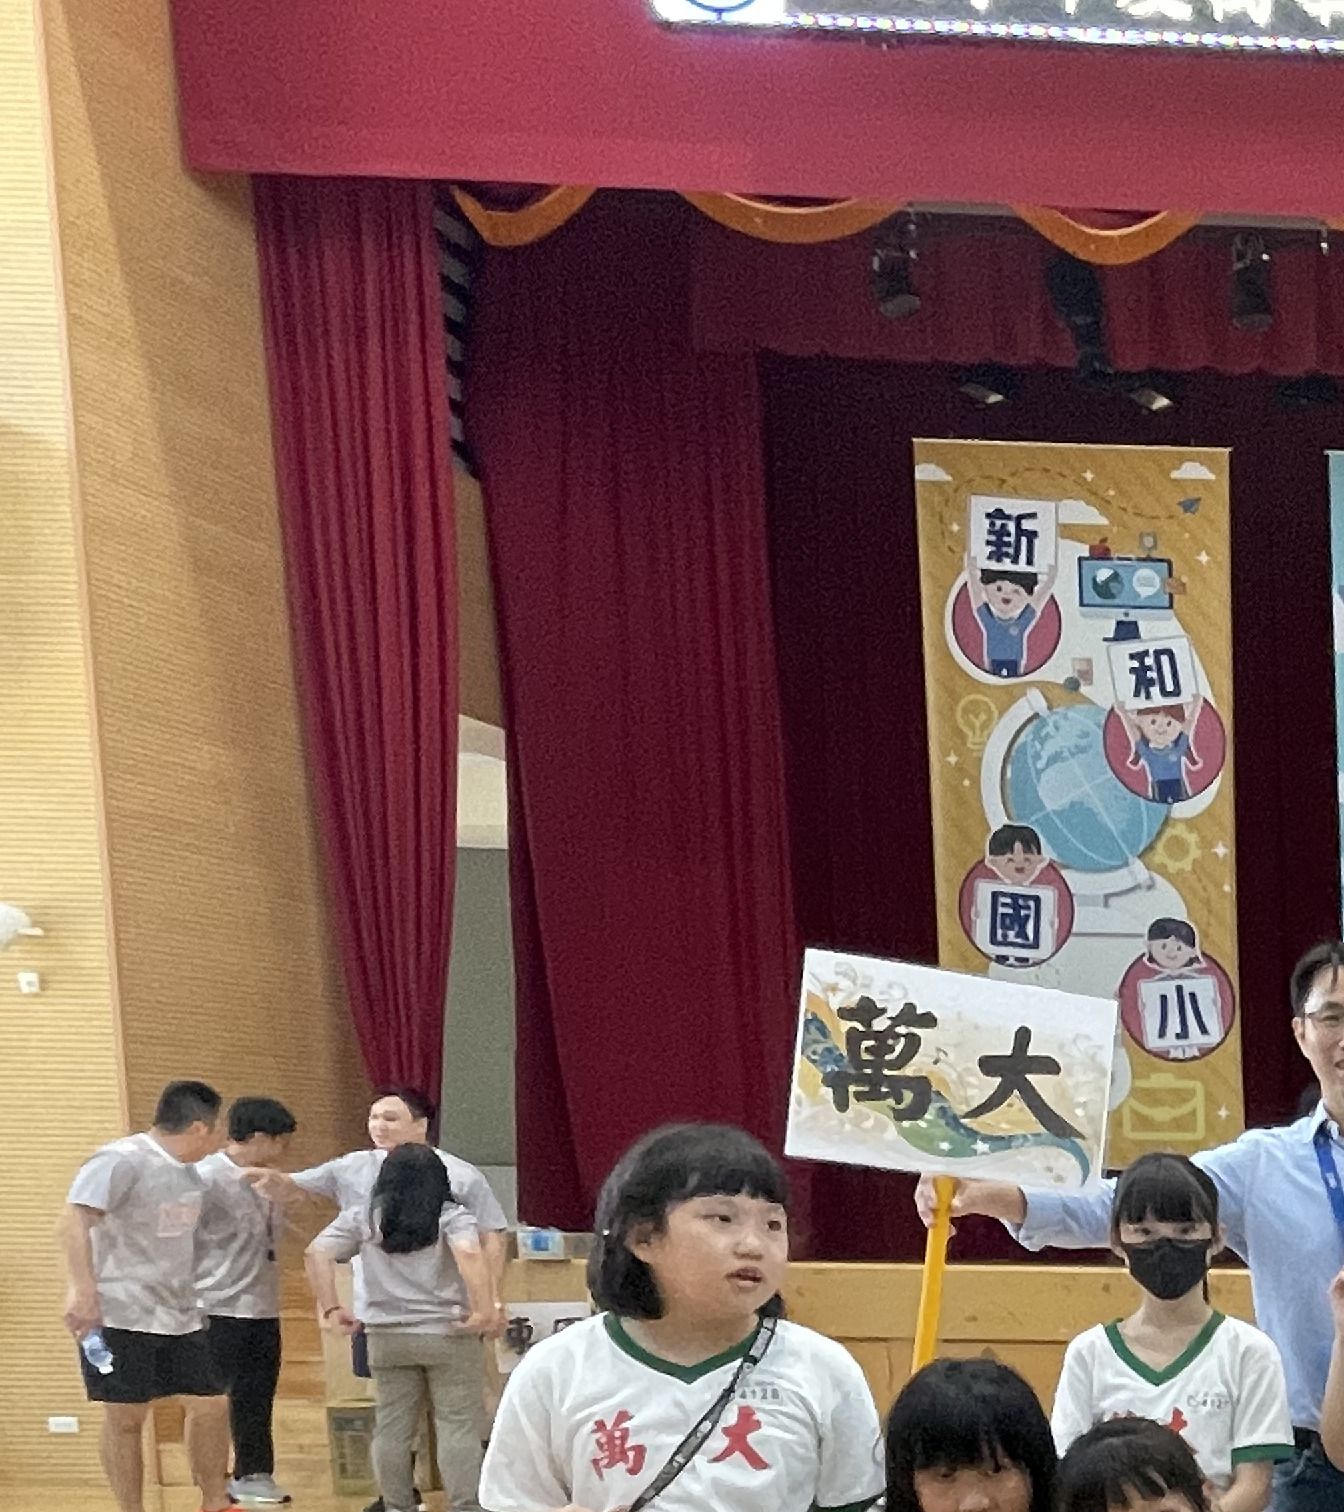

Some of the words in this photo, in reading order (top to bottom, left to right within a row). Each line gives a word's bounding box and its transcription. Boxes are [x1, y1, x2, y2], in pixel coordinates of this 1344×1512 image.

[985, 509, 1038, 566] 新
[1128, 648, 1183, 701] 和
[990, 892, 1042, 948] 國
[1158, 984, 1209, 1039] 小
[820, 994, 1086, 1141] 萬大
